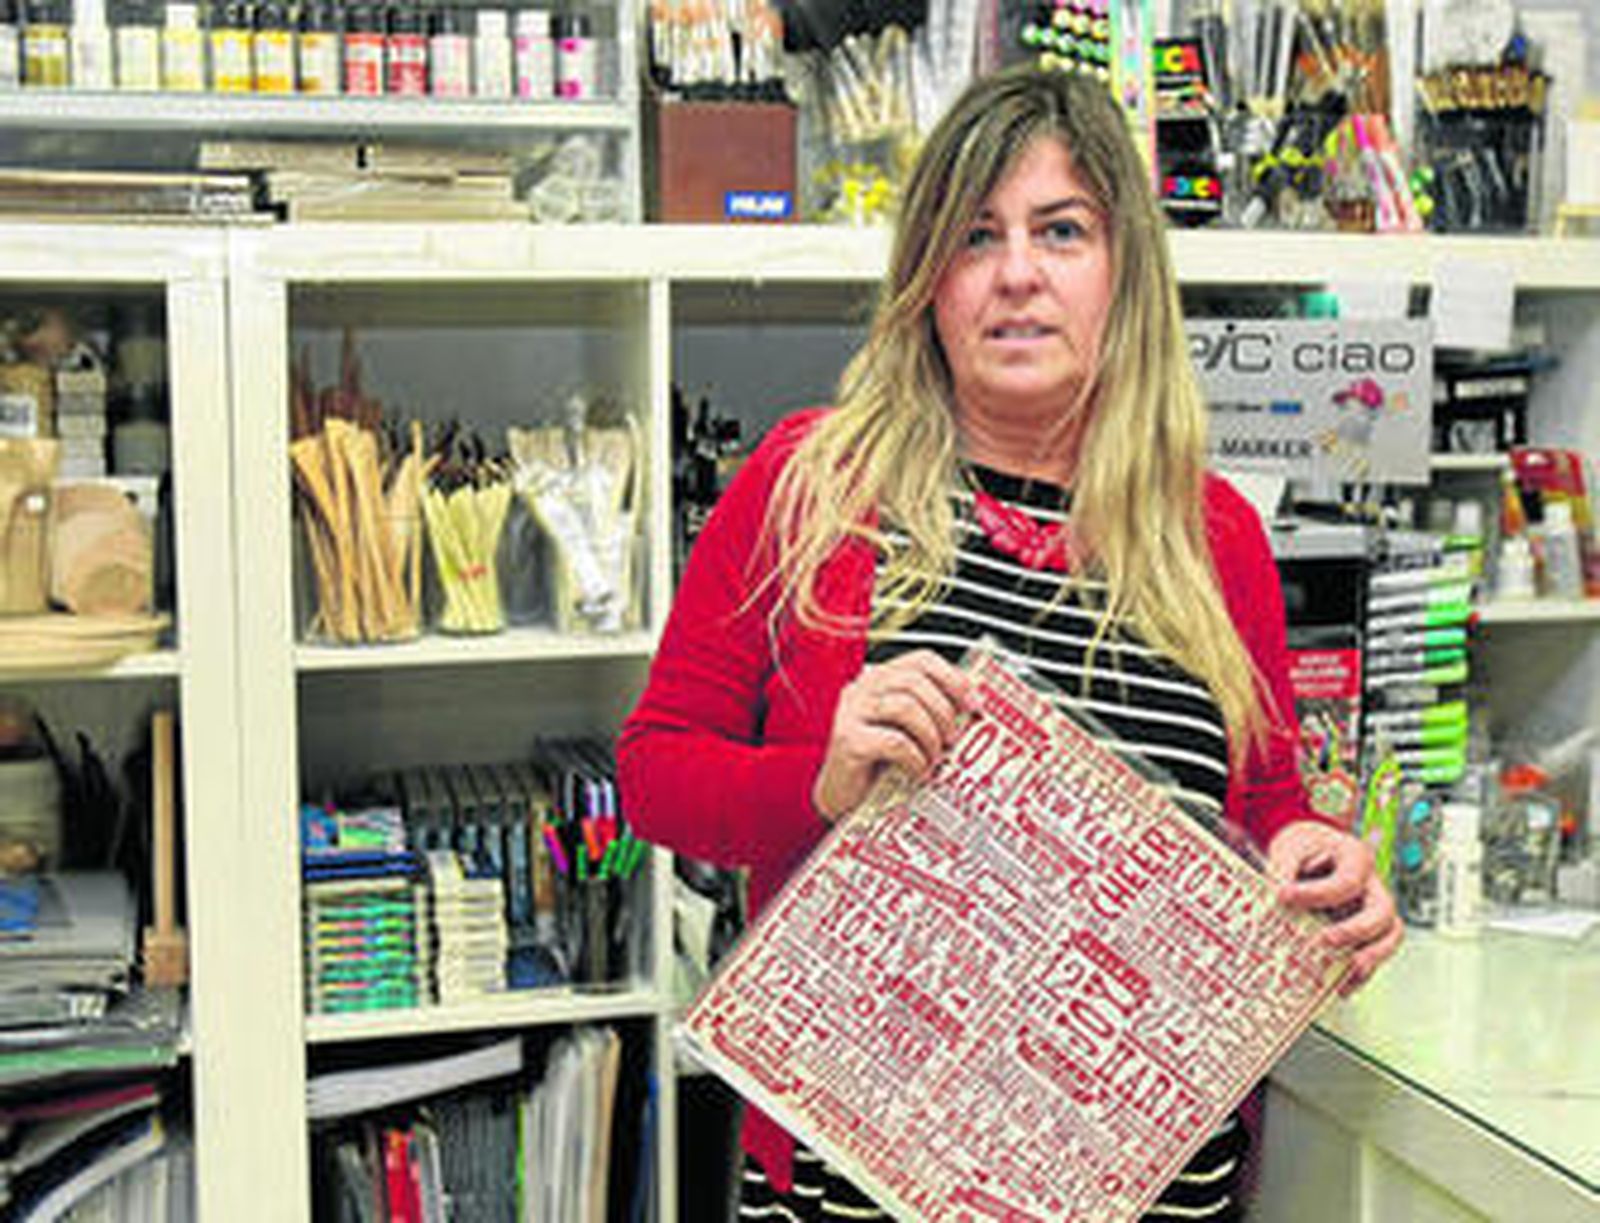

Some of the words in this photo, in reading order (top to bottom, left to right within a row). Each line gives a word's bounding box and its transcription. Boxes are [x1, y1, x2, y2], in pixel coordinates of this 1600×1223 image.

[1292, 331, 1415, 373] ciao
[1219, 436, 1312, 458] MARKER
[1085, 821, 1180, 926] CHEER
[1031, 945, 1088, 1004] 12
[1050, 971, 1138, 1061] JOY
[1091, 1038, 1197, 1136] HARK
